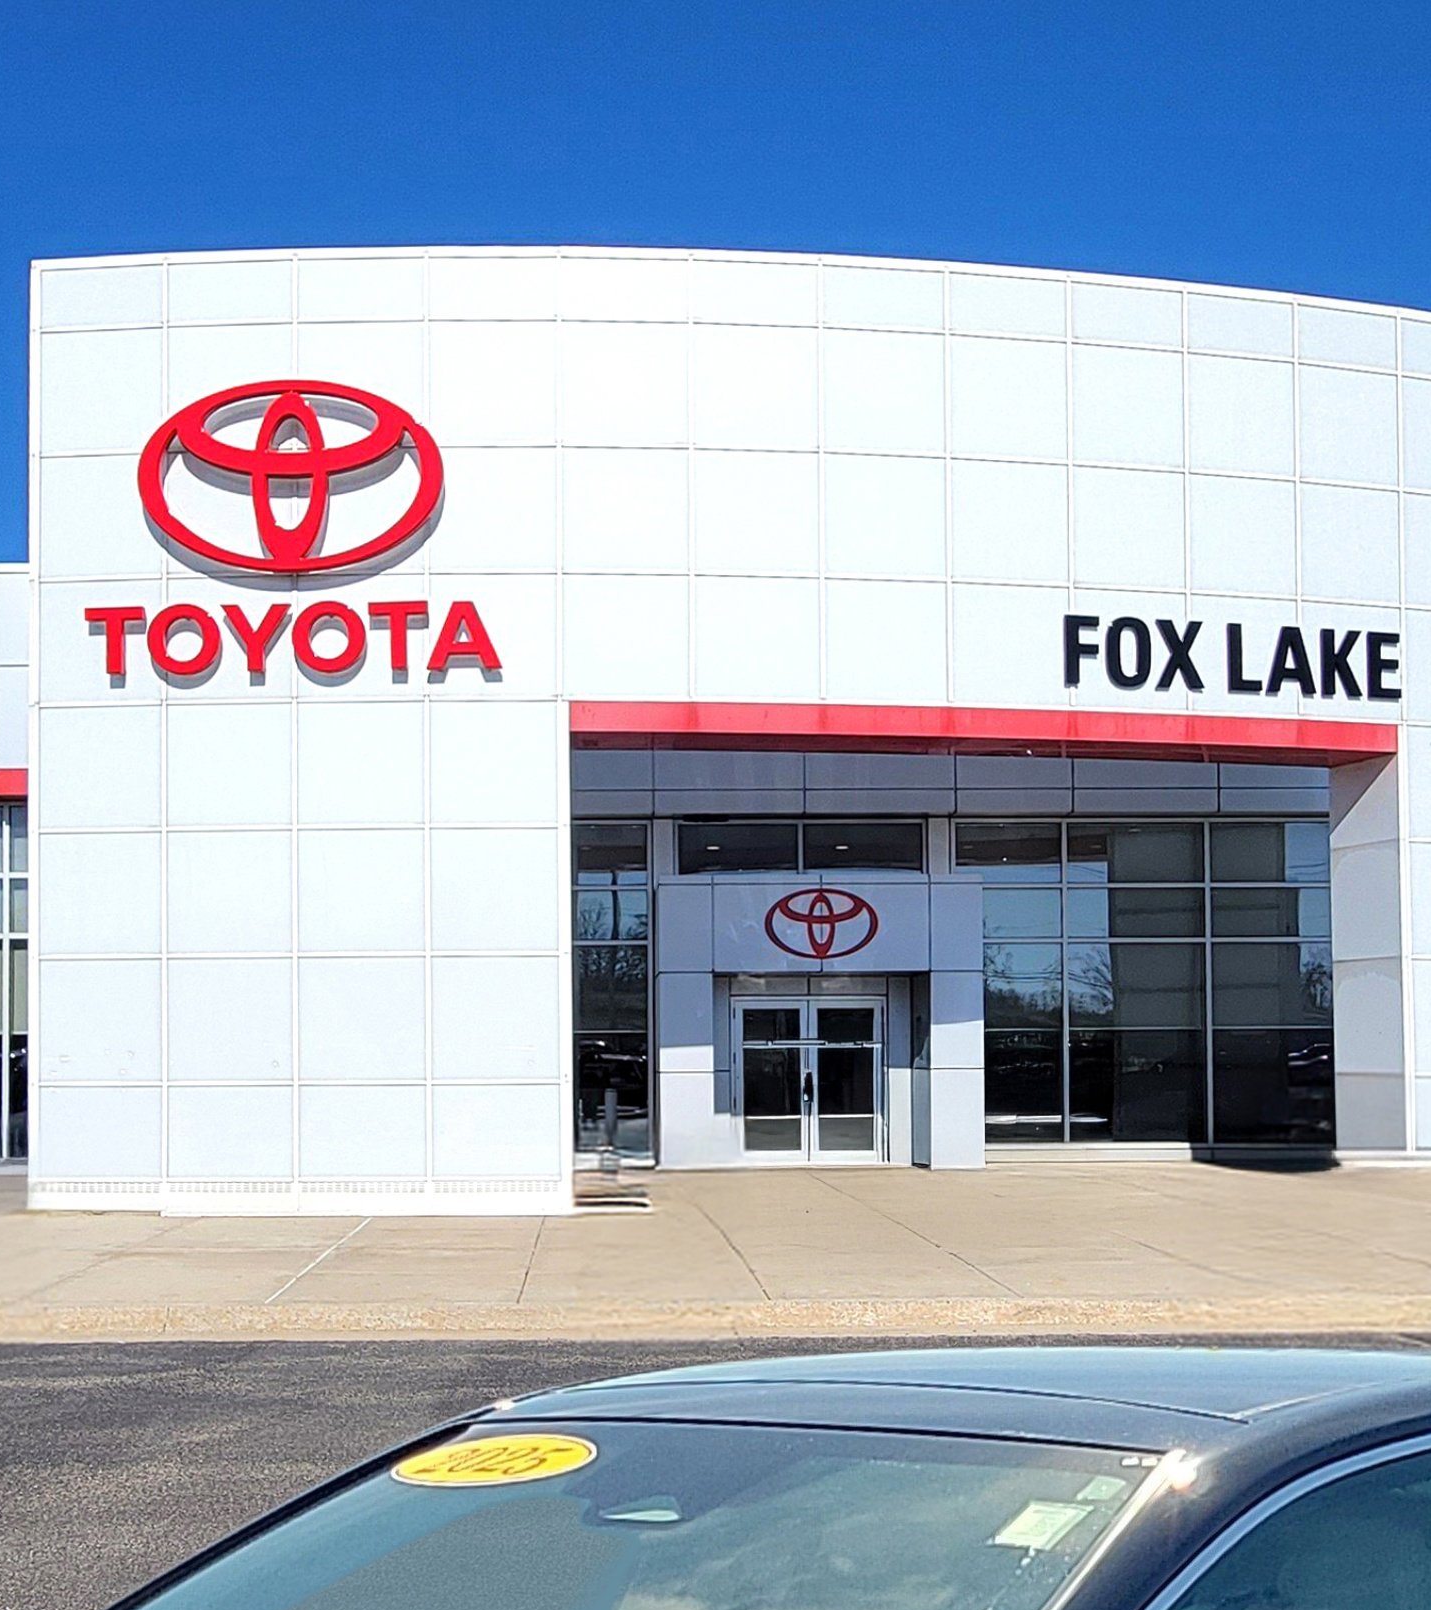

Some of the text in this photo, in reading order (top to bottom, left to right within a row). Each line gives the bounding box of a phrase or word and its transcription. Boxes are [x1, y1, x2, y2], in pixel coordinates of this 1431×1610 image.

[84, 601, 503, 676] TOYOTA
[1063, 614, 1402, 699] FOX LAKE
[412, 1446, 574, 1475] 2025
